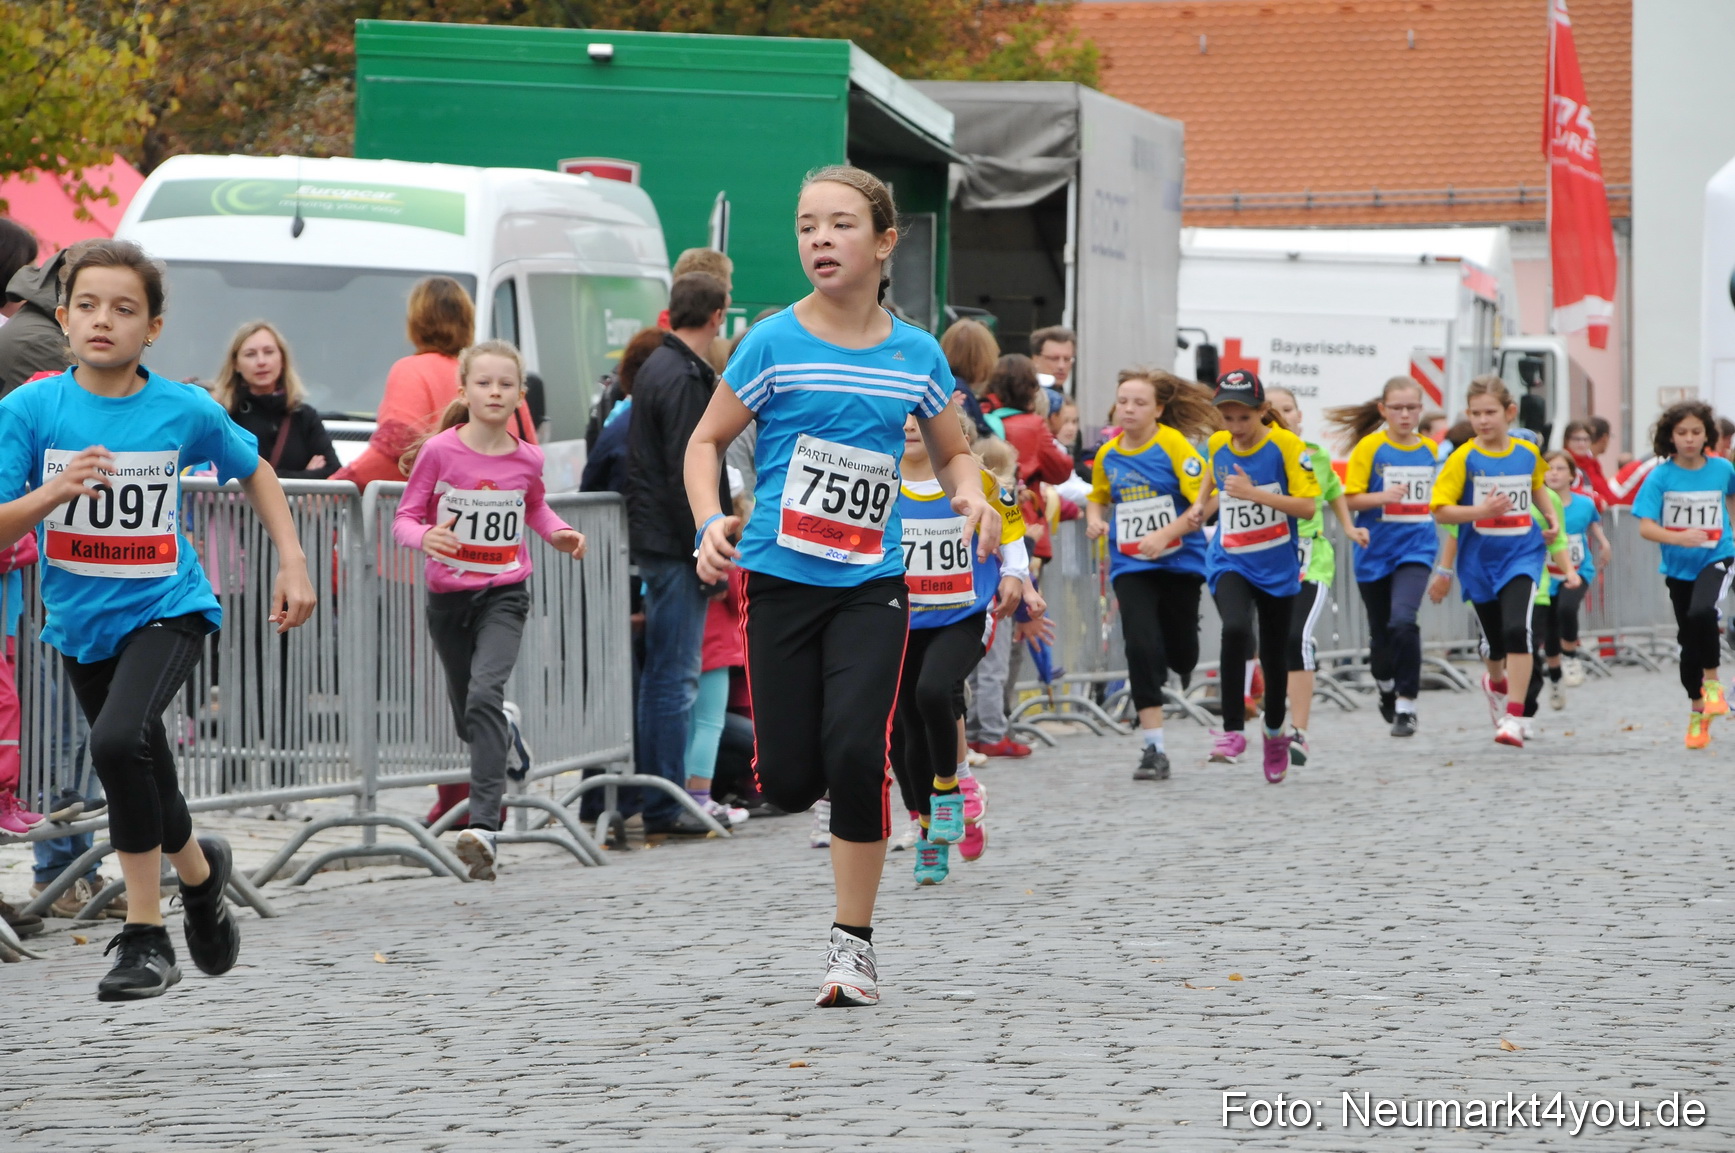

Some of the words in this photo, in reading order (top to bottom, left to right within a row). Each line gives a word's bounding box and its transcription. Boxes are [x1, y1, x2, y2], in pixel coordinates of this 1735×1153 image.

[296, 185, 398, 199] Europcar
[1271, 338, 1377, 356] Bayerisches
[1270, 360, 1319, 375] Rotes
[797, 445, 835, 465] PARTL
[838, 457, 889, 477] Neumarkt
[799, 465, 890, 523] 7599
[64, 483, 168, 530] 7097
[1670, 505, 1718, 525] 7117
[447, 507, 518, 541] 7180
[902, 528, 922, 536] RTL
[924, 527, 962, 536] Neumarkt
[1122, 511, 1171, 539] 7240
[71, 540, 156, 560] Katharina
[900, 538, 969, 571] 7196
[921, 580, 953, 591] Elena
